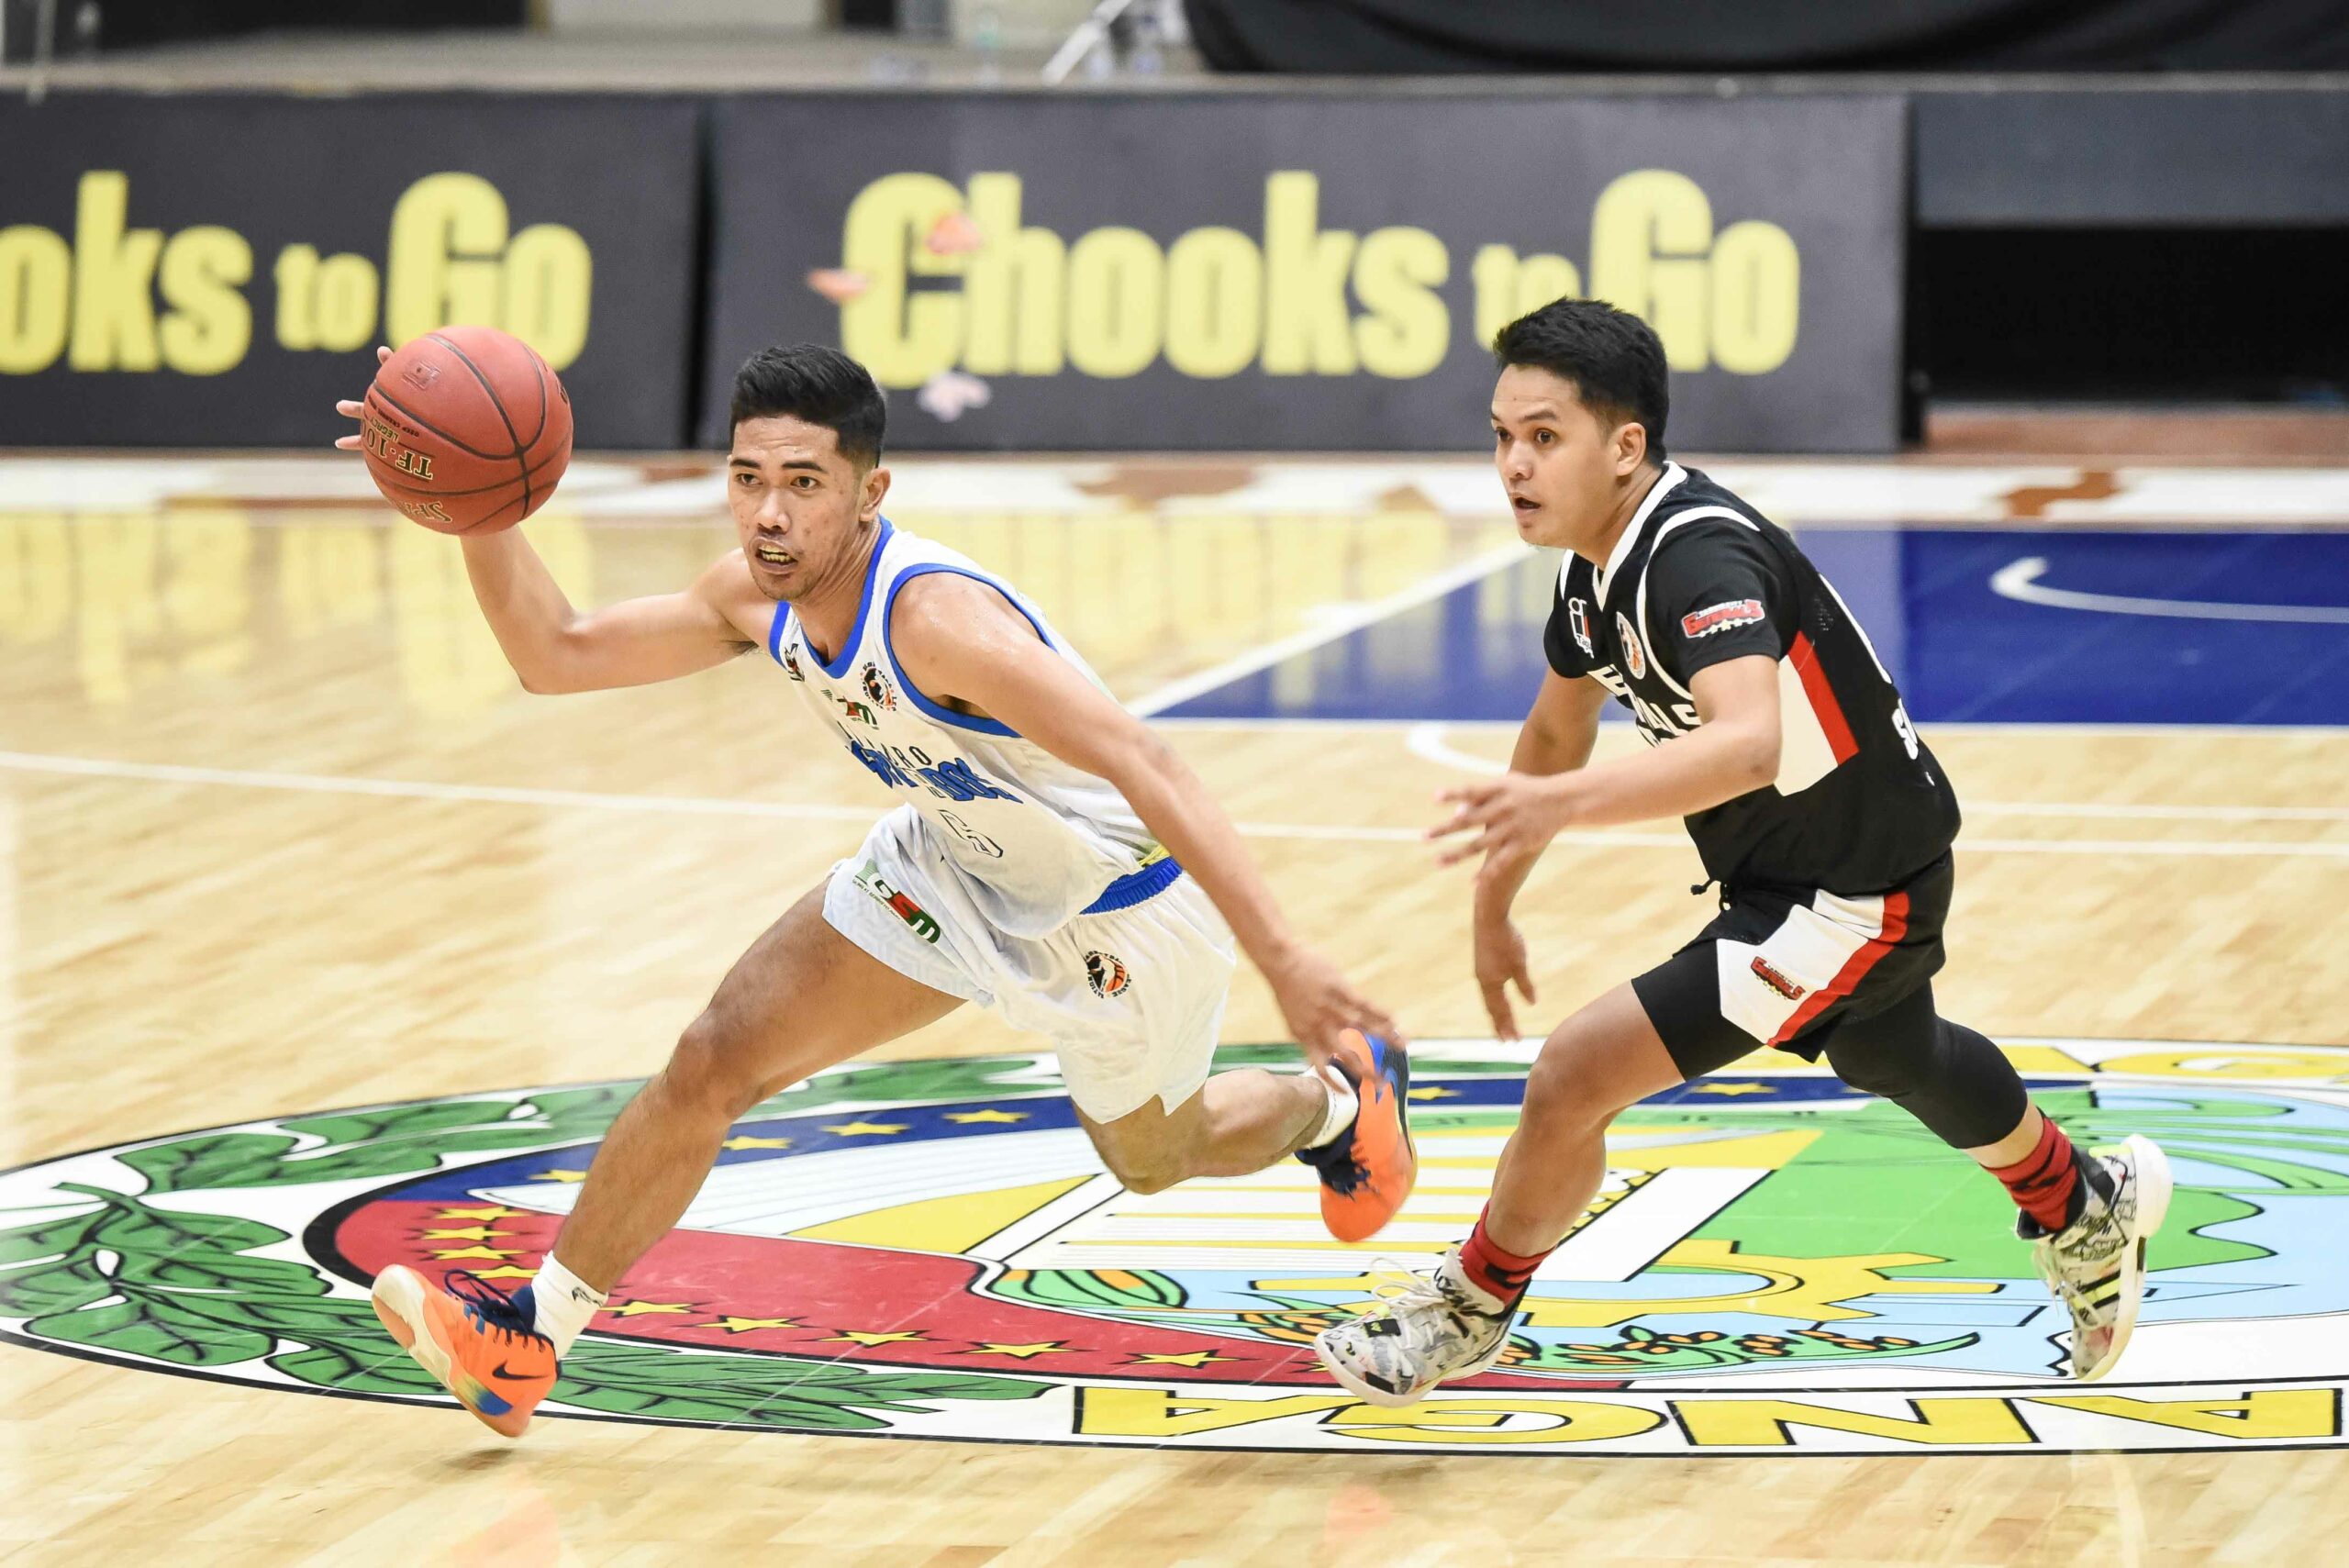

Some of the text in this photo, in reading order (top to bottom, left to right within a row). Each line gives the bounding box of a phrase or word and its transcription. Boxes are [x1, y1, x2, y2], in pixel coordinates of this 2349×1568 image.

[275, 243, 379, 352] to
[385, 172, 593, 373] Go
[841, 171, 1452, 387] Chooks
[1590, 169, 1800, 374] Go
